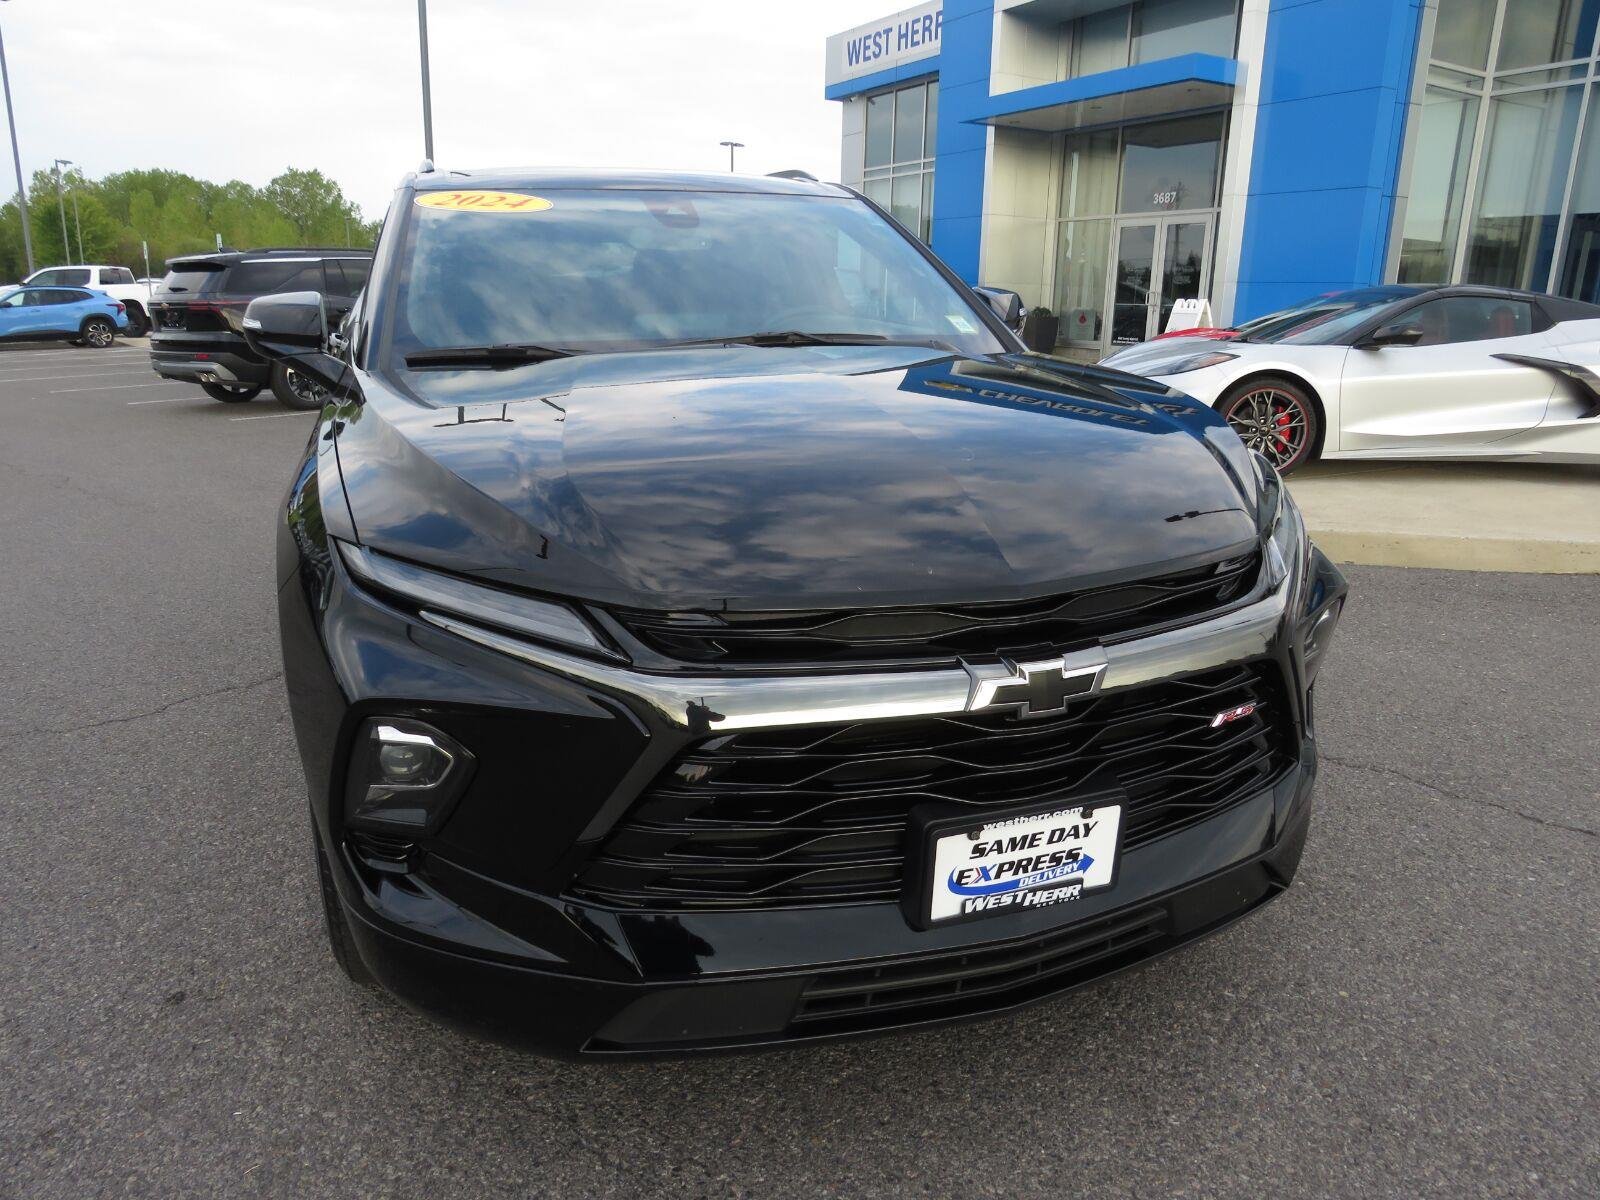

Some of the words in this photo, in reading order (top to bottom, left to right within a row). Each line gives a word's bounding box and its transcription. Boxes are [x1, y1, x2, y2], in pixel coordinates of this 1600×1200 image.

[847, 26, 893, 67] WEST
[433, 193, 532, 209] 2024
[1153, 191, 1177, 205] 3687
[983, 806, 1084, 830] westherr.com
[969, 831, 1045, 860] SAME
[1046, 820, 1099, 845] DAY
[955, 846, 1083, 886] EXPRESS
[1018, 860, 1082, 888] DELIVERY
